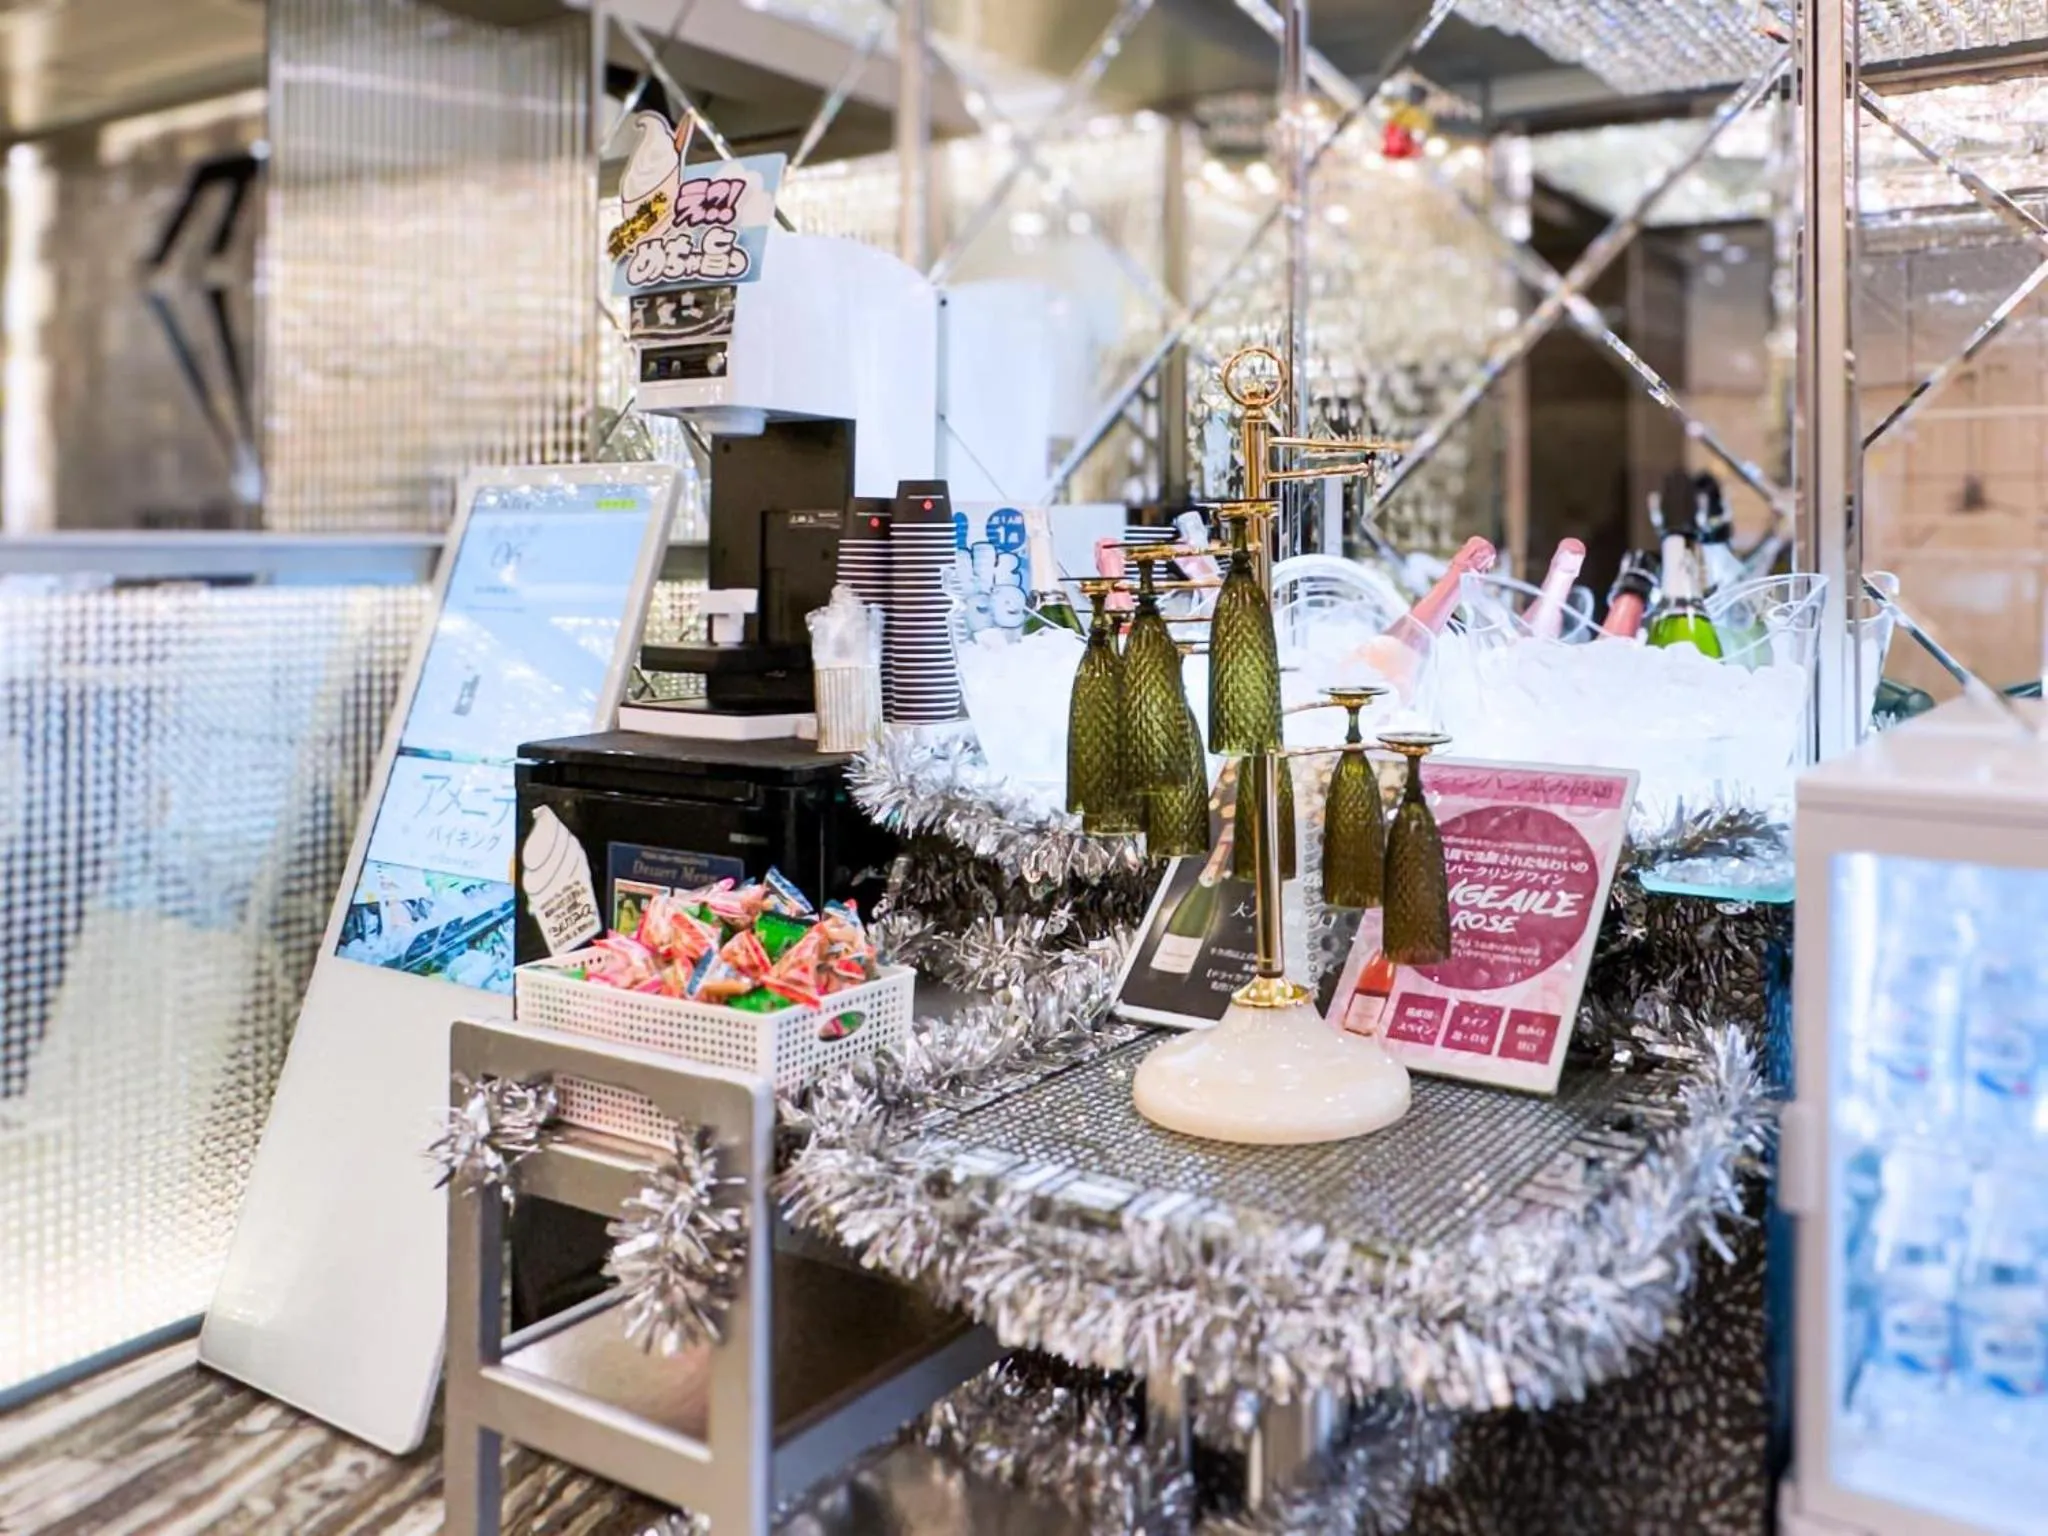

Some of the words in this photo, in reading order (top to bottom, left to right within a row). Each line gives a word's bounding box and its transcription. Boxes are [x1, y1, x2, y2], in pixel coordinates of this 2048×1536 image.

[1445, 863, 1566, 885] パークリングワイン
[1450, 910, 1520, 933] ROSE
